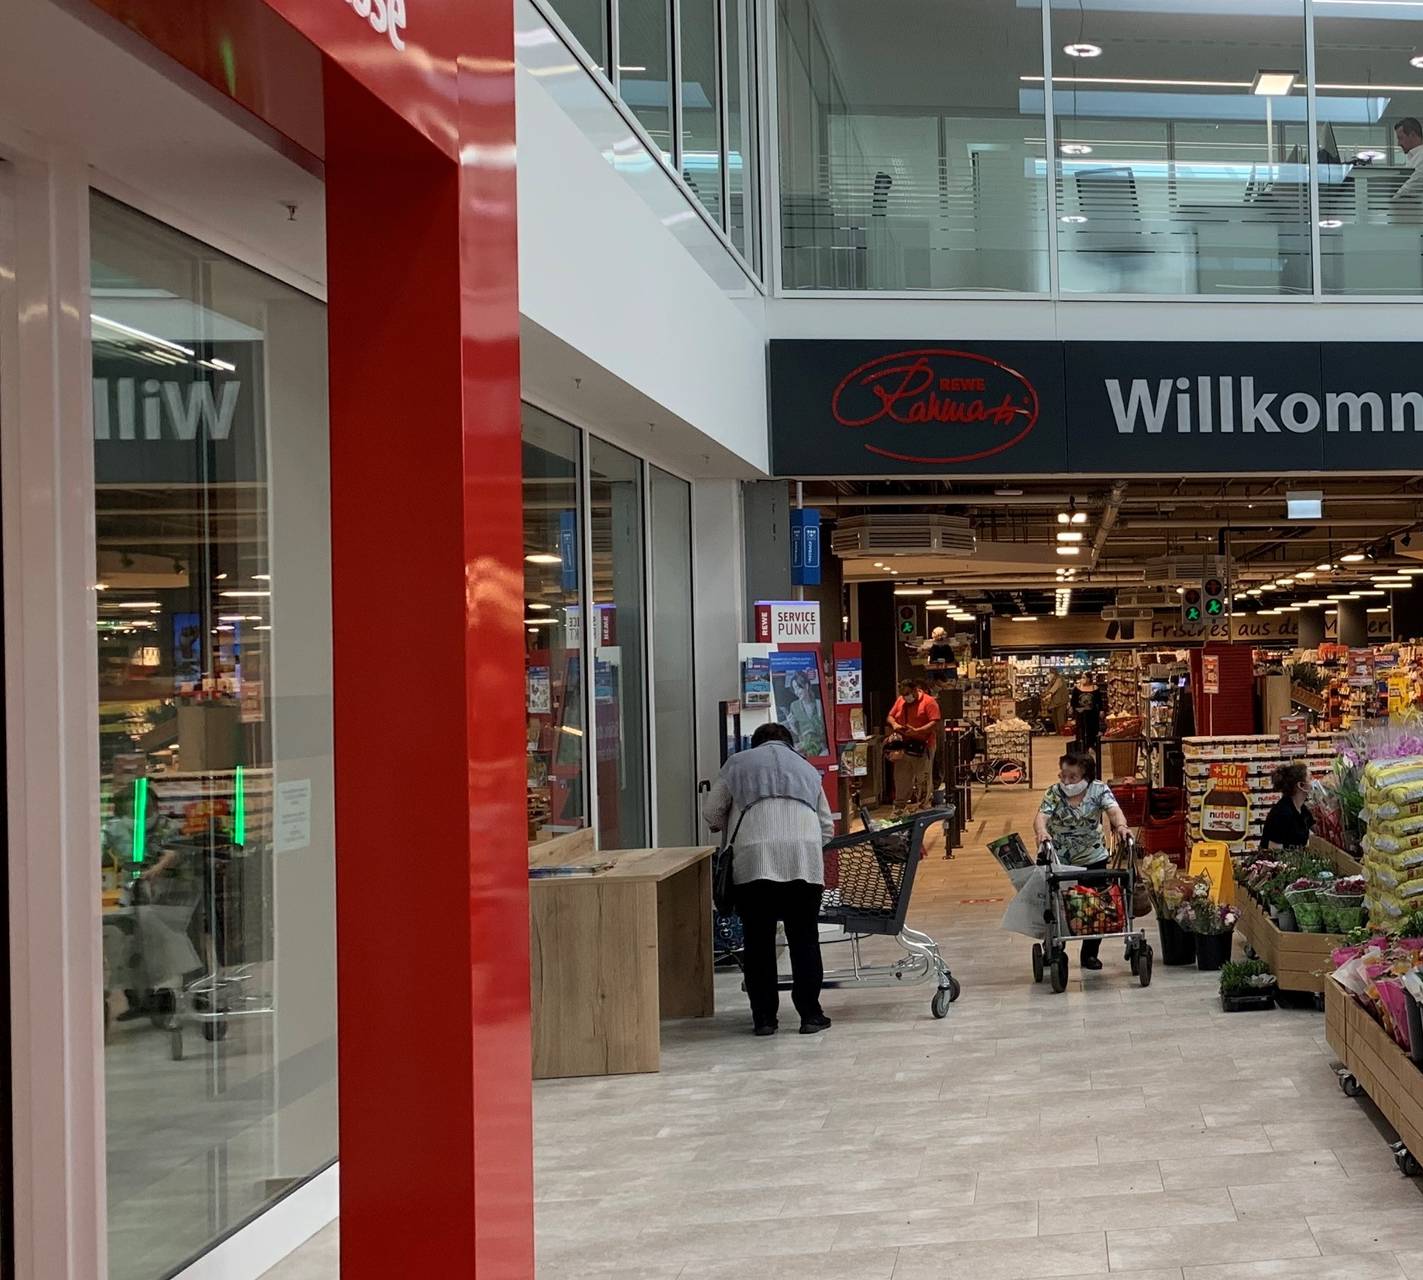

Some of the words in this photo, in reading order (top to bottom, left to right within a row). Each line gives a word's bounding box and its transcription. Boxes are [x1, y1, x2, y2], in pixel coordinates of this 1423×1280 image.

[938, 377, 986, 391] REWE
[777, 612, 816, 622] SERVICE
[778, 623, 816, 636] PUNKT
[1238, 622, 1270, 637] aus
[1217, 777, 1244, 786] GRATIS
[1209, 811, 1240, 820] nutella
